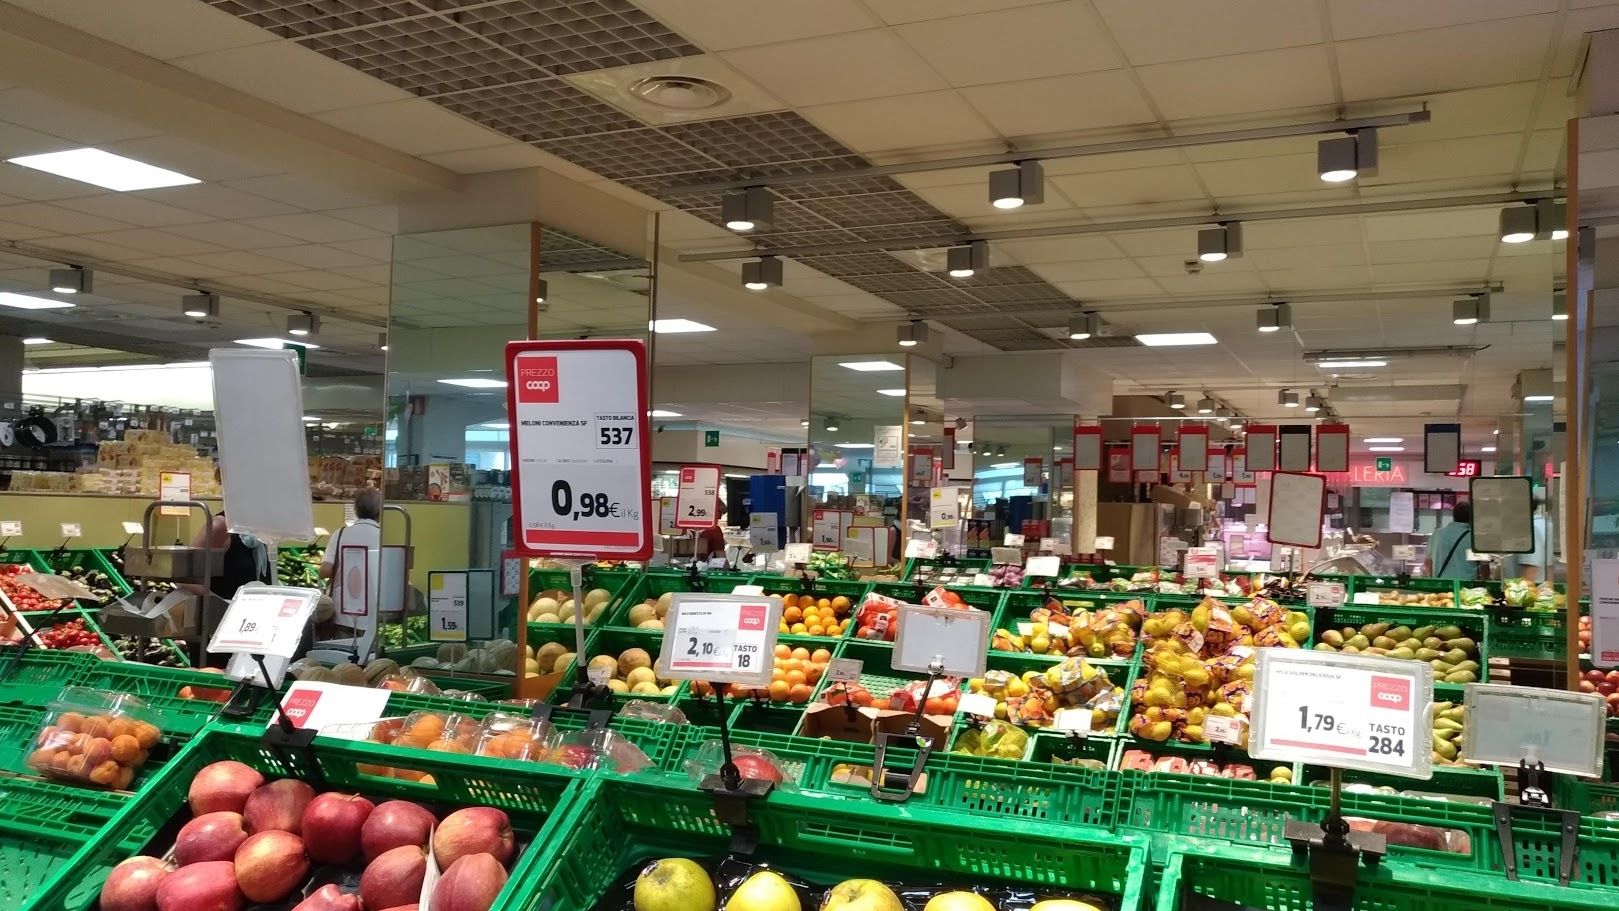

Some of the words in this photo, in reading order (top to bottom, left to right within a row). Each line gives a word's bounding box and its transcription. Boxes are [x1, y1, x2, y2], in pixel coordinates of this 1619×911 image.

[526, 381, 551, 391] coop
[600, 428, 633, 445] 537
[1348, 466, 1404, 482] LERIA
[627, 509, 639, 520] Kg
[738, 655, 751, 668] 18
[1373, 682, 1408, 692] PREZZO
[1378, 693, 1402, 704] coop
[1369, 723, 1405, 736] TASTO
[1368, 735, 1405, 757] 284
